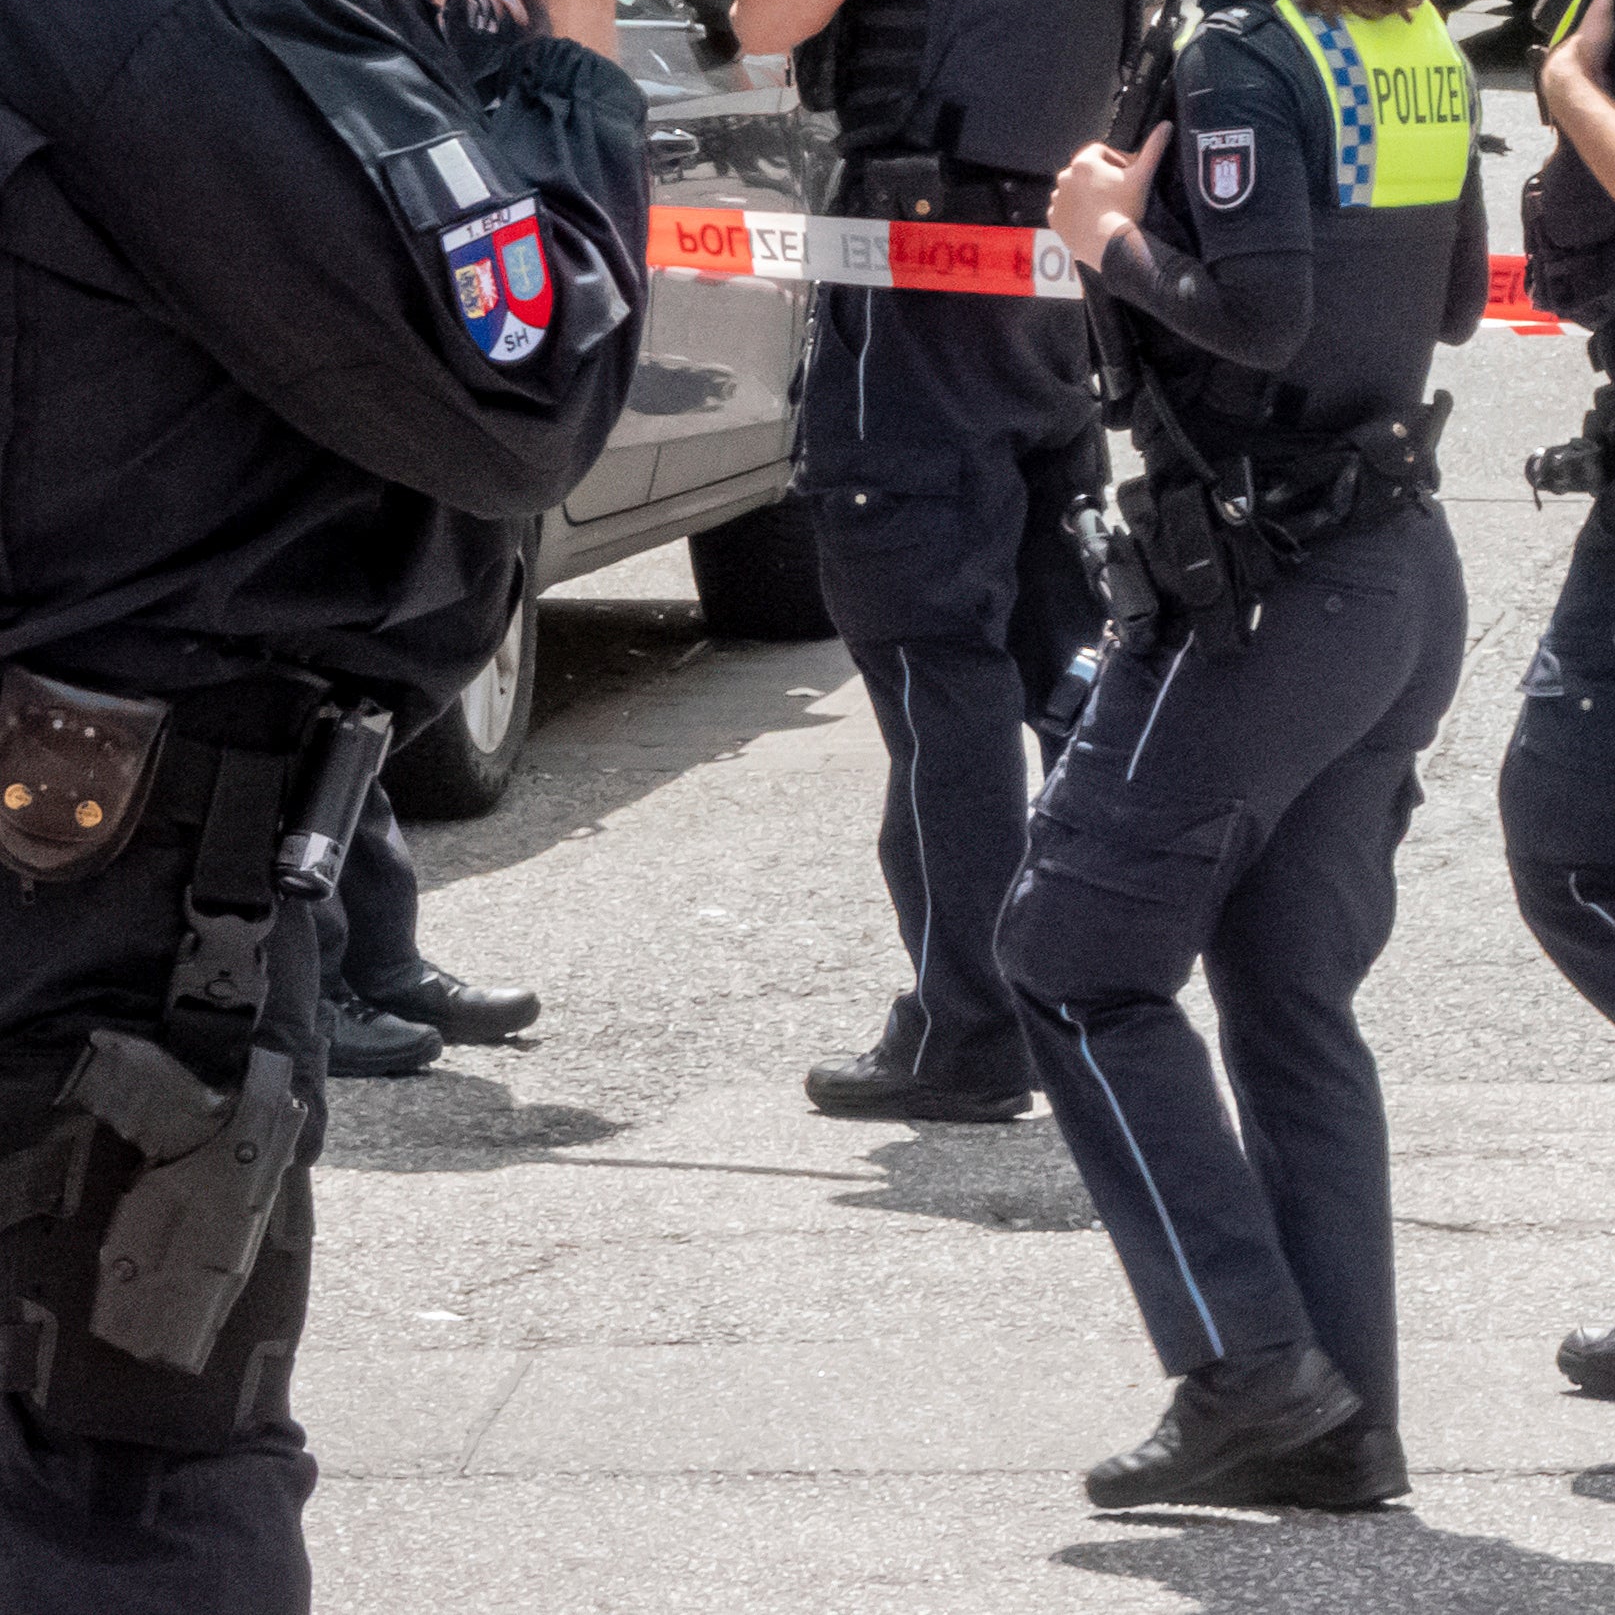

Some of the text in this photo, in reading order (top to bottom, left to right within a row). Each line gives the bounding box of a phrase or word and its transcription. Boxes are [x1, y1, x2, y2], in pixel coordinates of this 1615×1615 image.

[1373, 64, 1468, 125] POLIZEI
[1200, 133, 1250, 150] POLIZEI
[503, 327, 530, 352] SH
